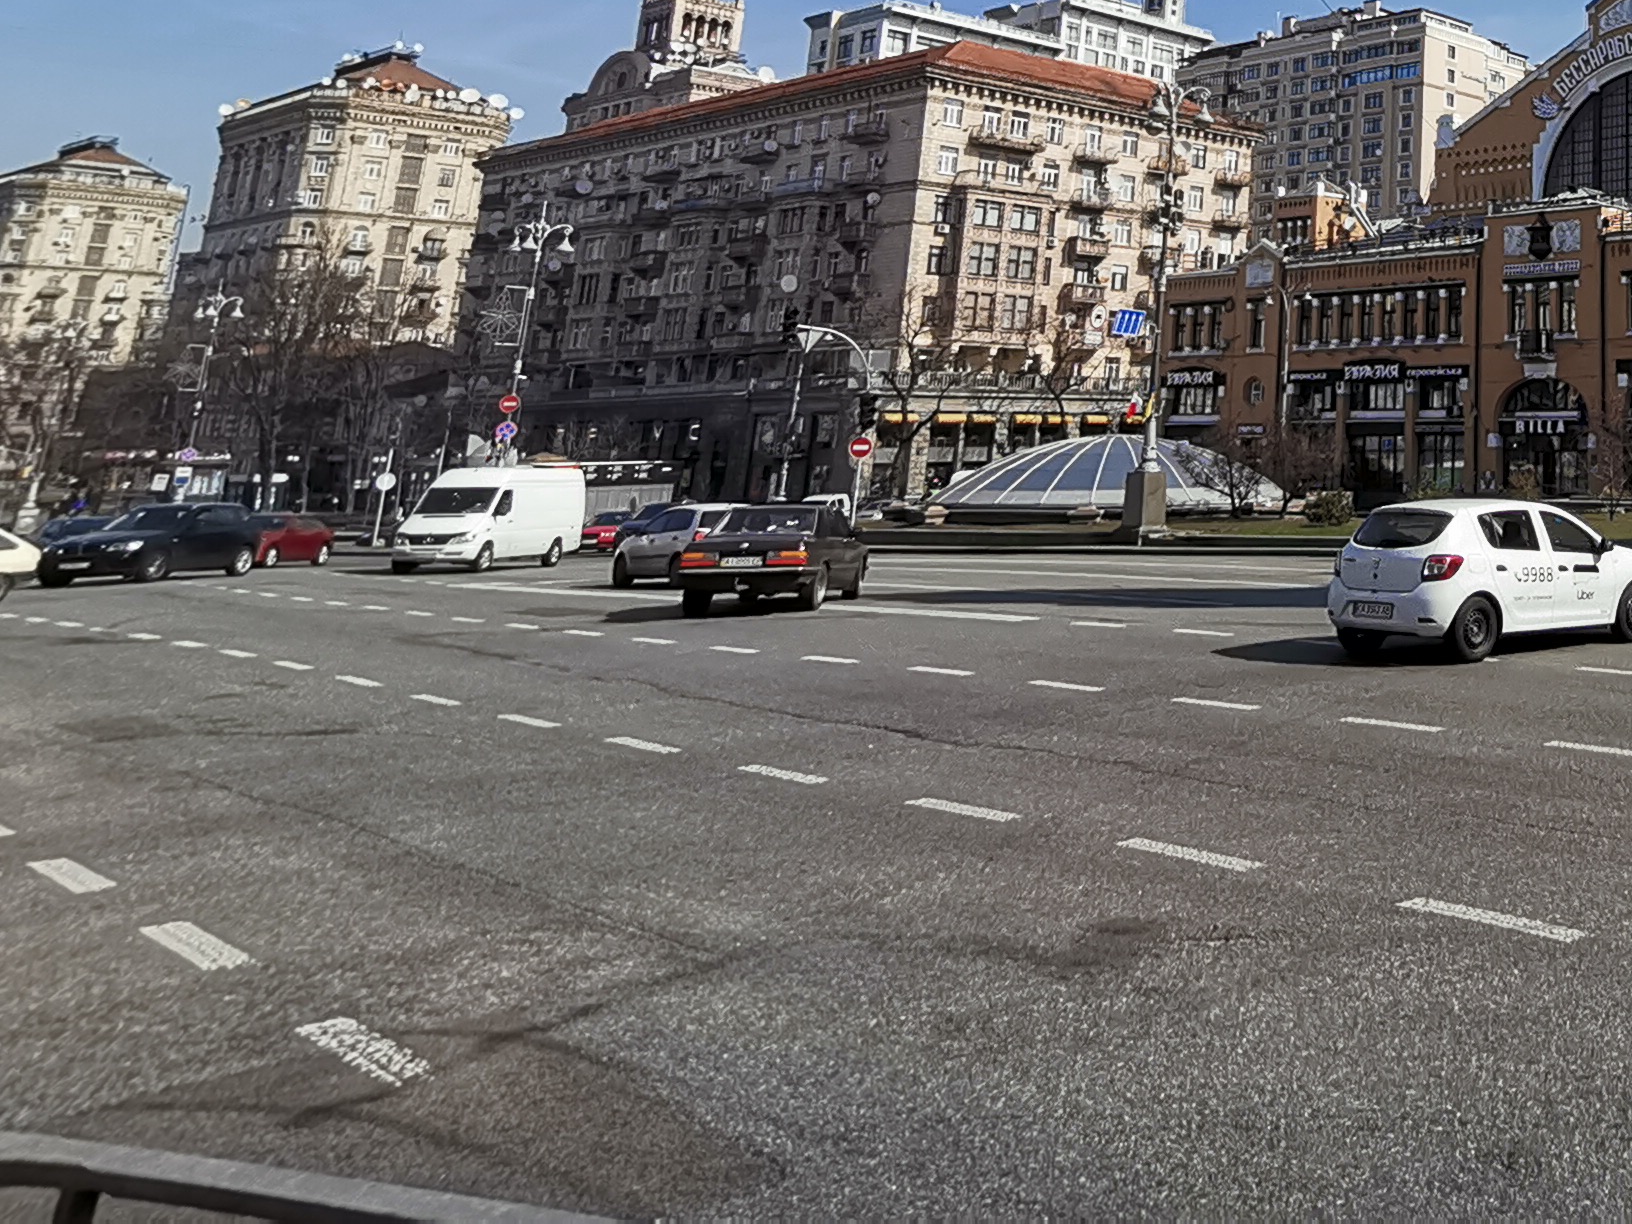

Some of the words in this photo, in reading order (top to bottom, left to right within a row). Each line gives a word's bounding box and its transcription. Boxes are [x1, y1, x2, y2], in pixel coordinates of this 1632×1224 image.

[1515, 419, 1566, 434] BILLA
[1522, 566, 1554, 583] 9988
[1576, 589, 1596, 600] Uber
